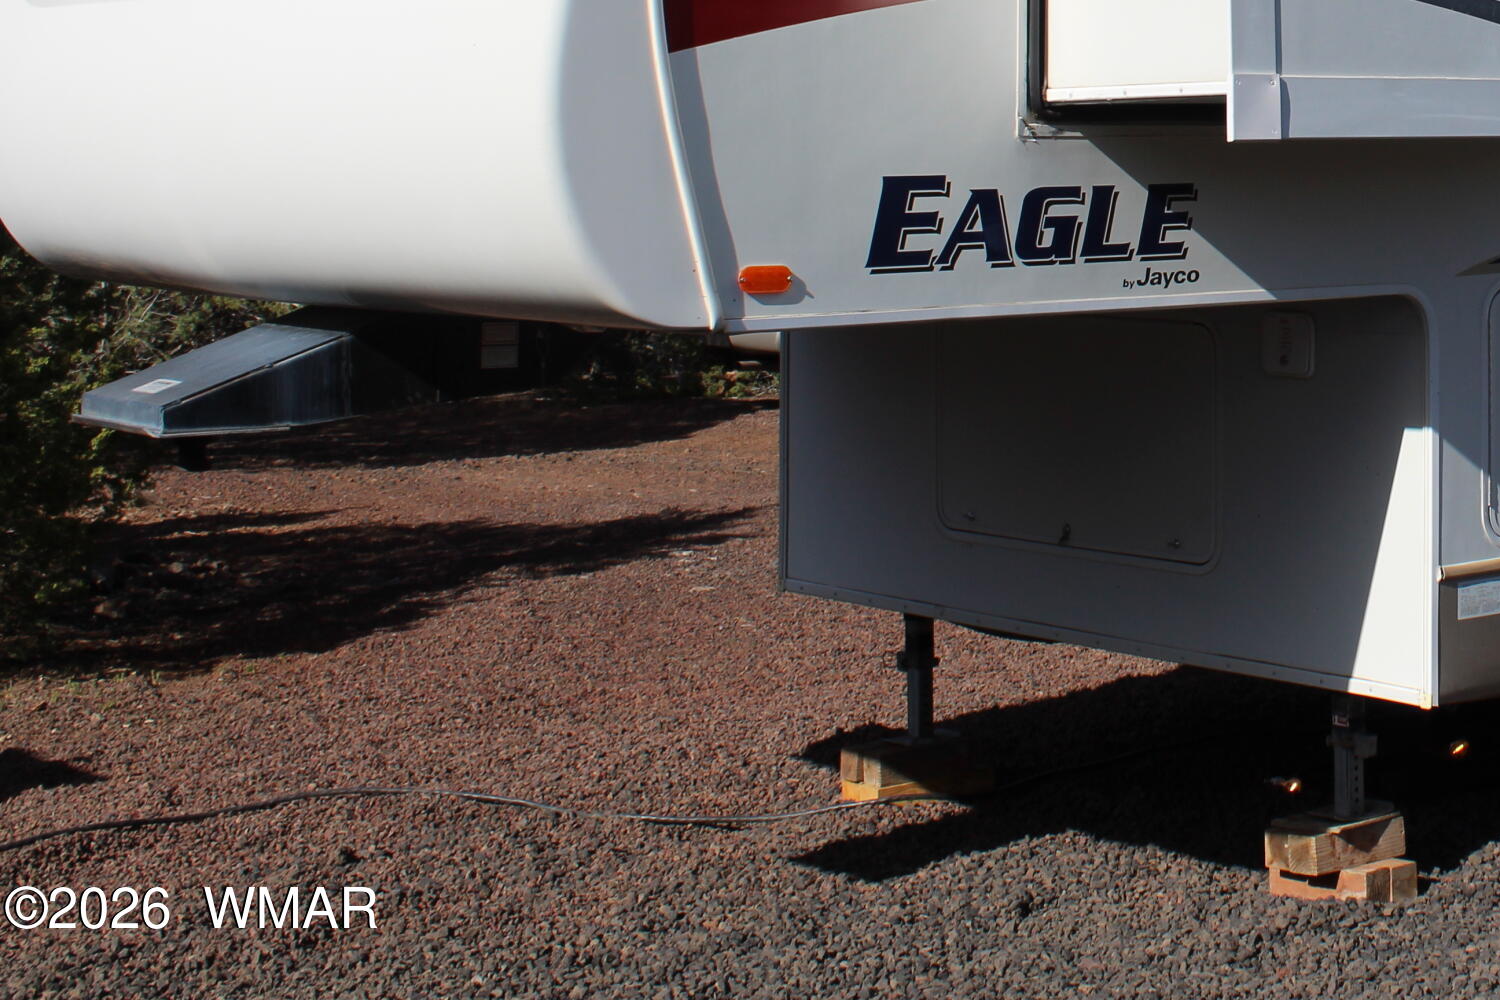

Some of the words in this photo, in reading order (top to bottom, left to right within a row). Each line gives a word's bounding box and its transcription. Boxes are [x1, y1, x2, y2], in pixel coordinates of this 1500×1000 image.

[865, 174, 1198, 275] EAGLE
[1122, 278, 1135, 290] by
[1136, 267, 1200, 289] Jayco
